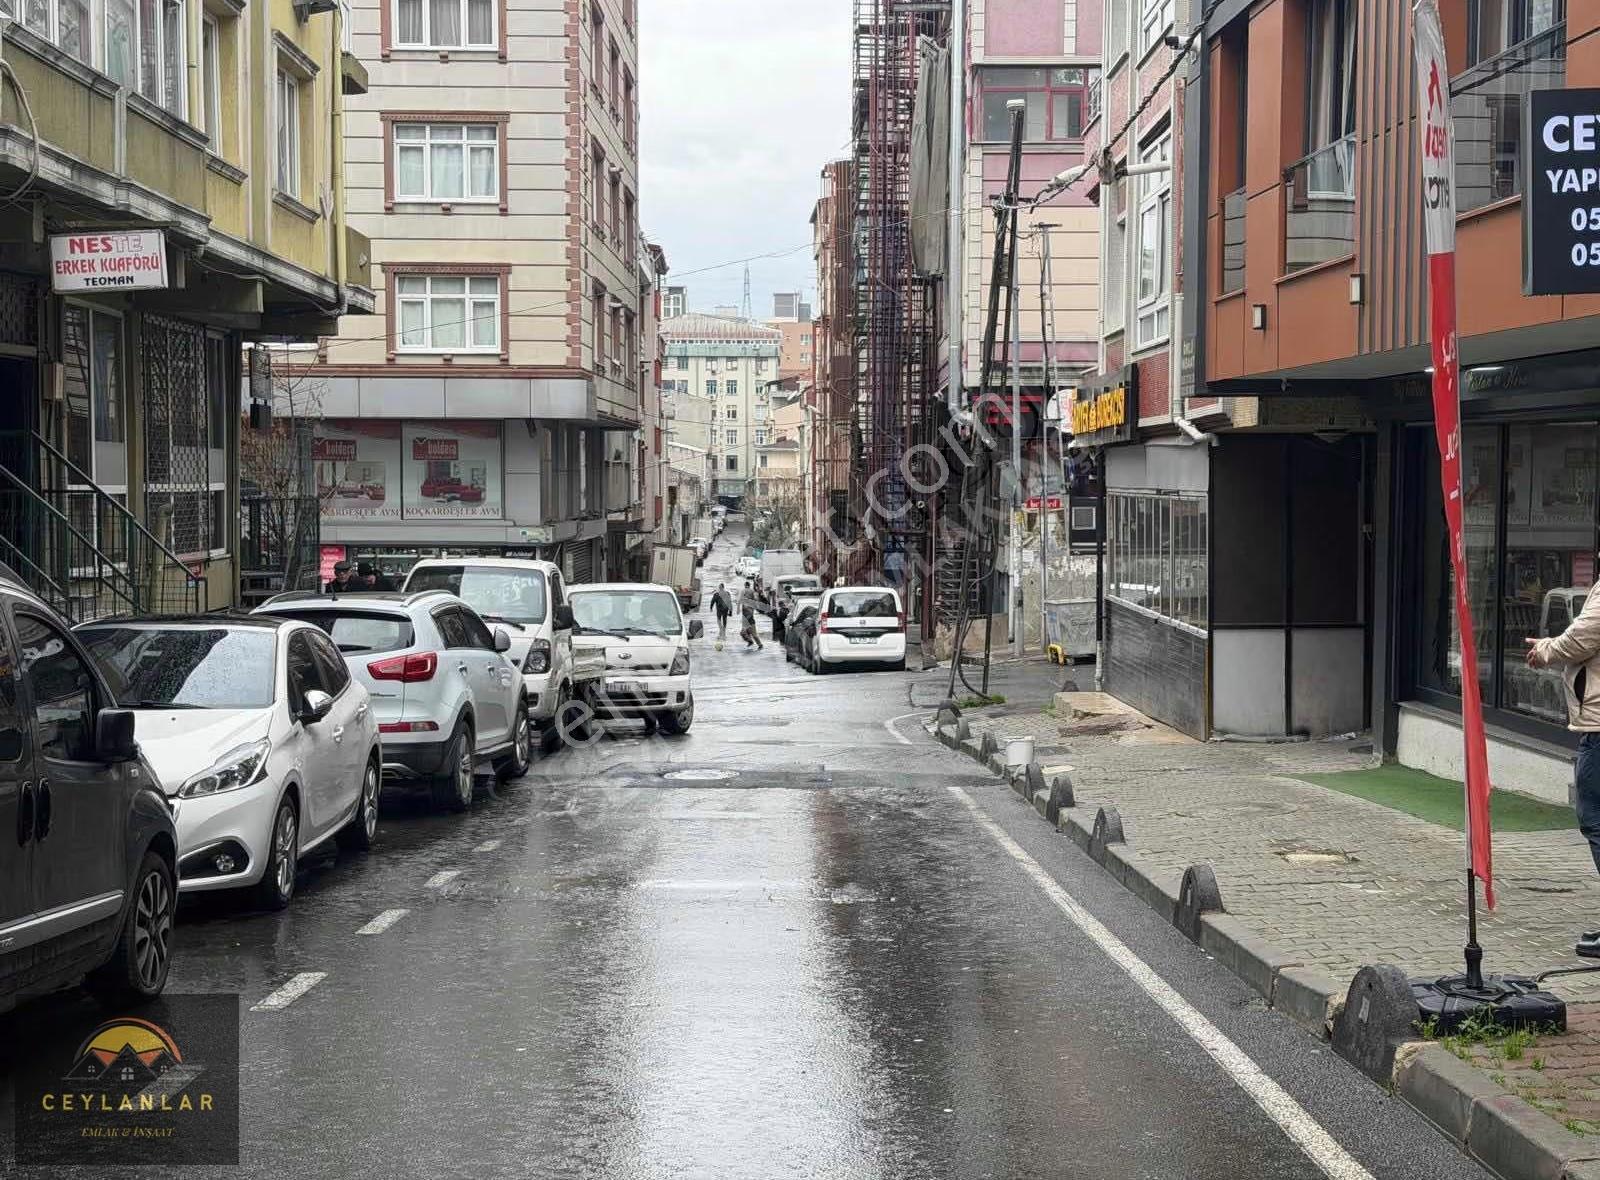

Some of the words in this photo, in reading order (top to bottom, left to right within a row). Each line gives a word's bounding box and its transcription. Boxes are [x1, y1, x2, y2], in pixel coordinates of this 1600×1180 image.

[1546, 168, 1600, 193] YAP
[56, 258, 96, 275] ERKEK
[100, 252, 160, 272] KUAFÖRÜ
[83, 275, 134, 286] TEOMAN
